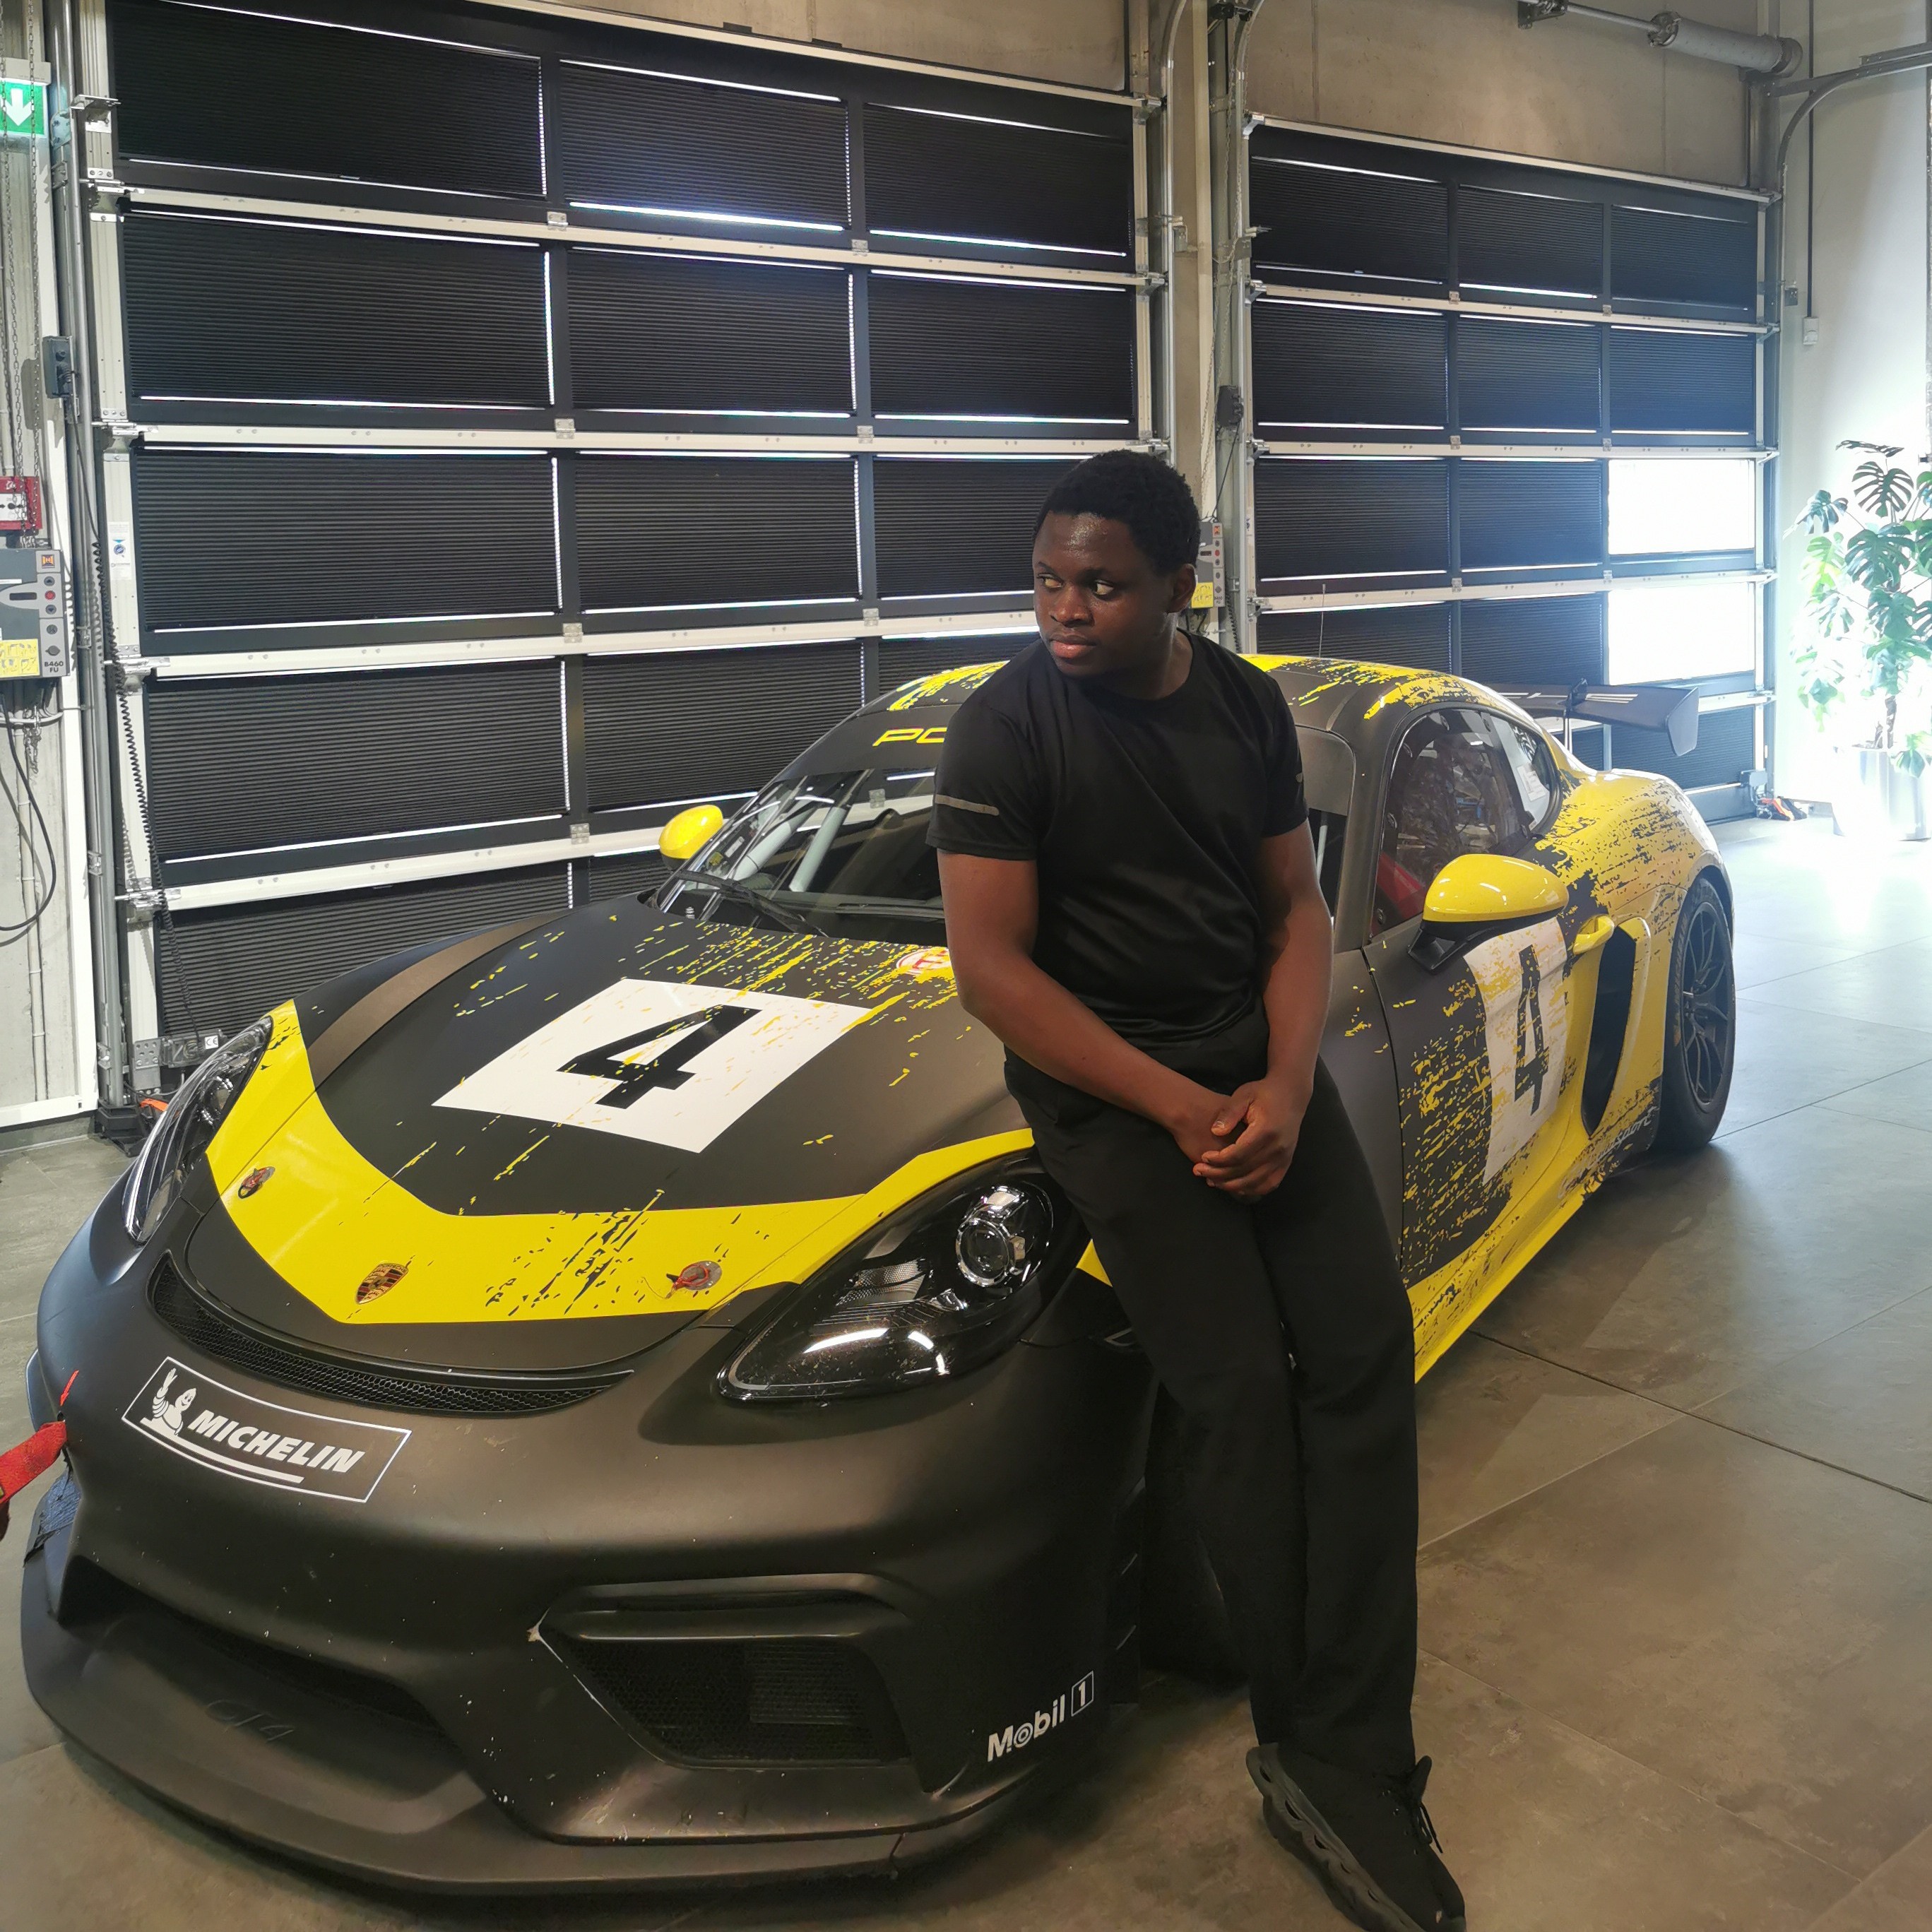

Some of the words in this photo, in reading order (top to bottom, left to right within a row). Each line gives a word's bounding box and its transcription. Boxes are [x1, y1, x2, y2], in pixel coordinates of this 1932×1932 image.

[556, 1004, 763, 1109] 4
[1515, 944, 1548, 1116] 4
[187, 1410, 365, 1473] MICHELIN
[988, 1694, 1065, 1762] Mobil
